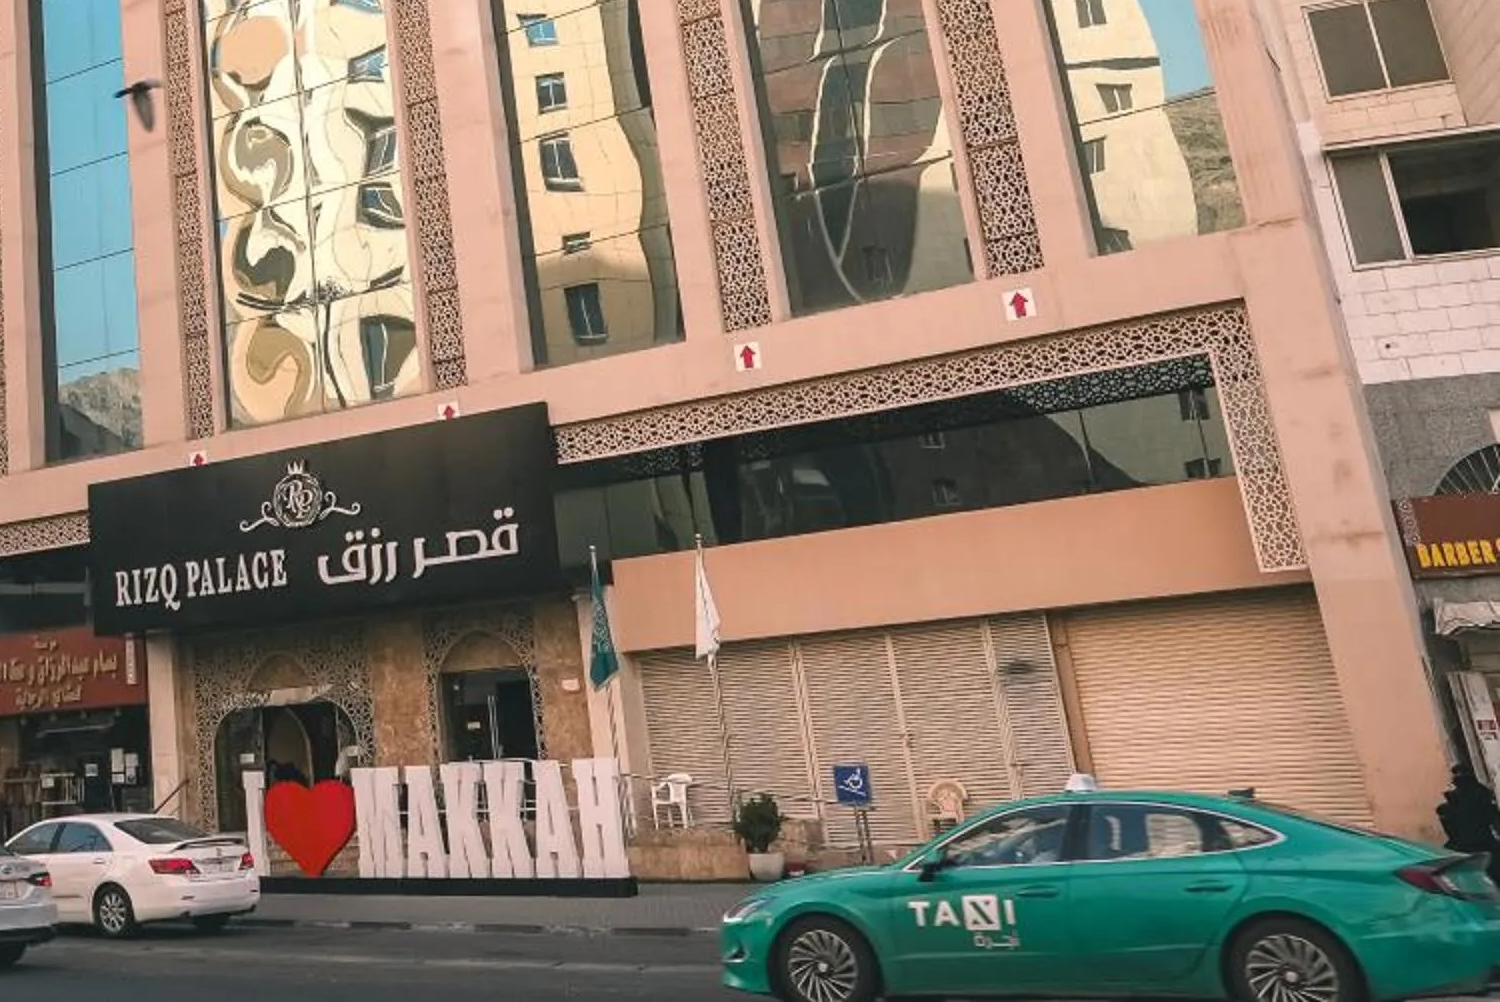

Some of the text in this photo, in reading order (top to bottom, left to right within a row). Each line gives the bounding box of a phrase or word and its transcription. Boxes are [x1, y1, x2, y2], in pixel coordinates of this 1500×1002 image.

[115, 549, 290, 611] RIZQ PALACE
[317, 507, 521, 586] قصر رزق
[351, 758, 631, 879] MAKKAH
[907, 895, 1017, 931] TAXI
